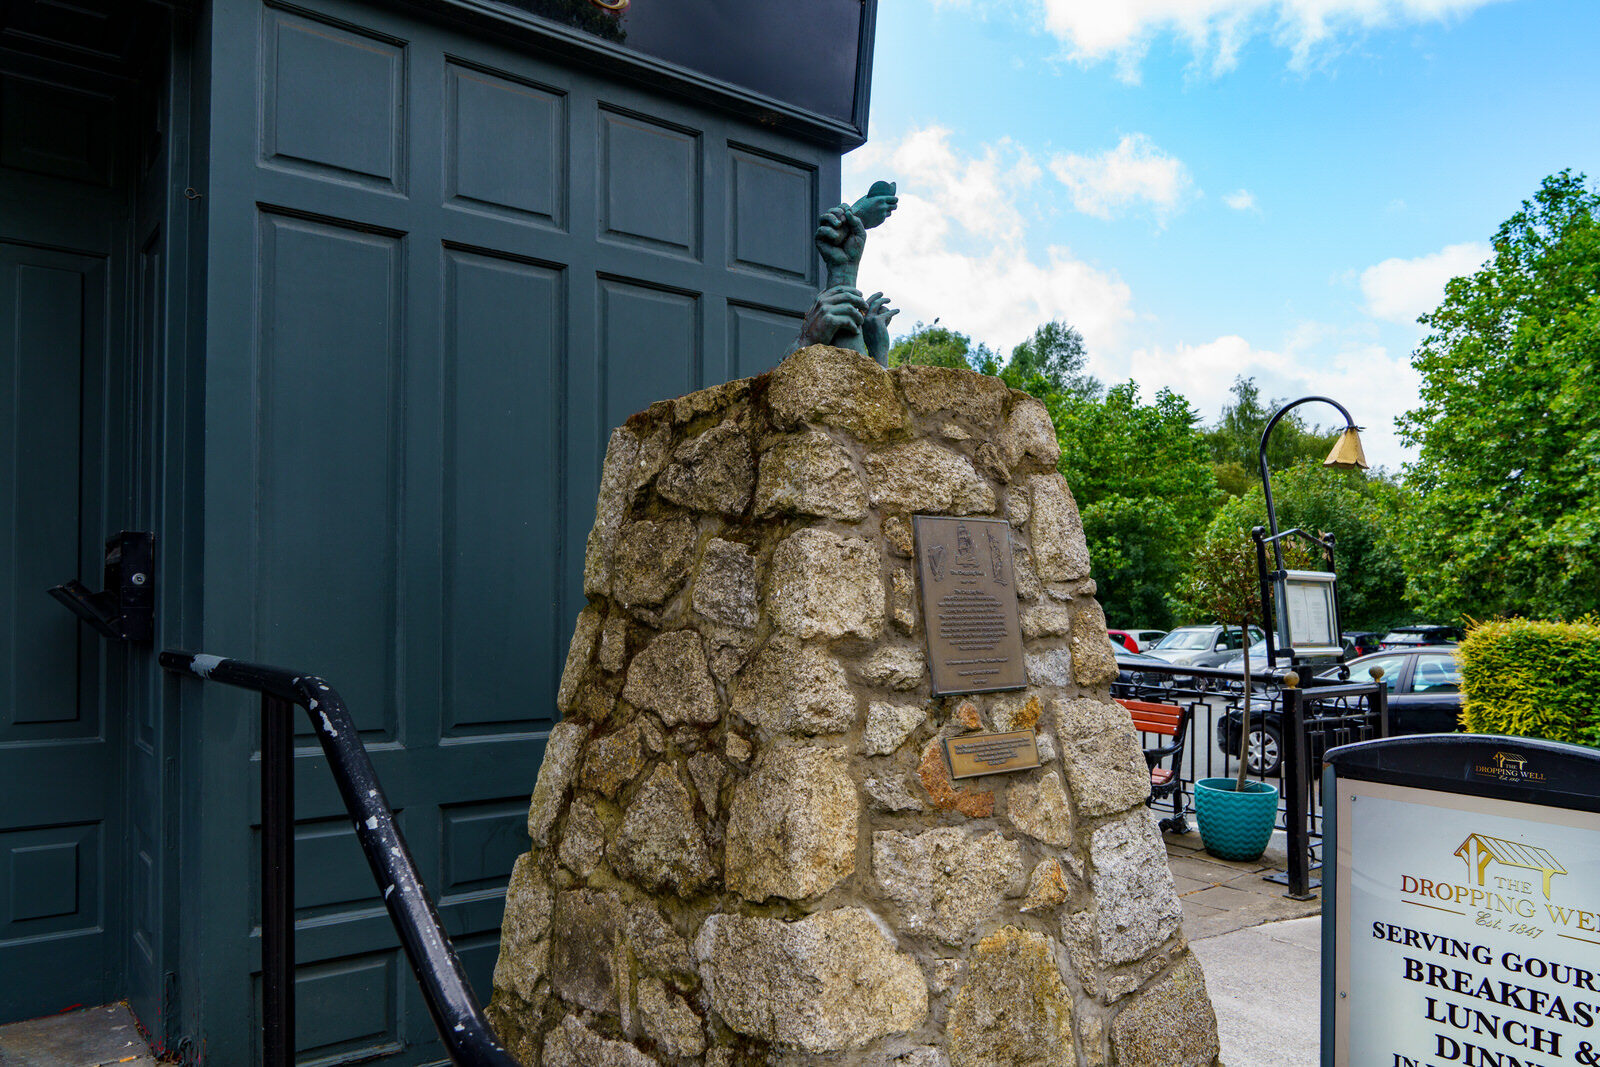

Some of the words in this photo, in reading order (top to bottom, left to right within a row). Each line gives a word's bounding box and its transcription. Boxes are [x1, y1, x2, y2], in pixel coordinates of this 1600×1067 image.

[1475, 765, 1518, 777] DROPPING
[1520, 771, 1546, 780] WELL
[1401, 874, 1537, 918] DROPPING
[1544, 903, 1600, 933] WE
[1494, 876, 1533, 895] THE
[1475, 910, 1502, 930] Est.
[1508, 922, 1544, 939] 1847
[1372, 921, 1493, 965] SERVING
[1501, 952, 1600, 993] GOUR
[1403, 956, 1600, 1028] BREAKFAS
[1424, 996, 1563, 1058] LUNCH
[1575, 1041, 1600, 1067] &
[1435, 1033, 1545, 1067] DIN
